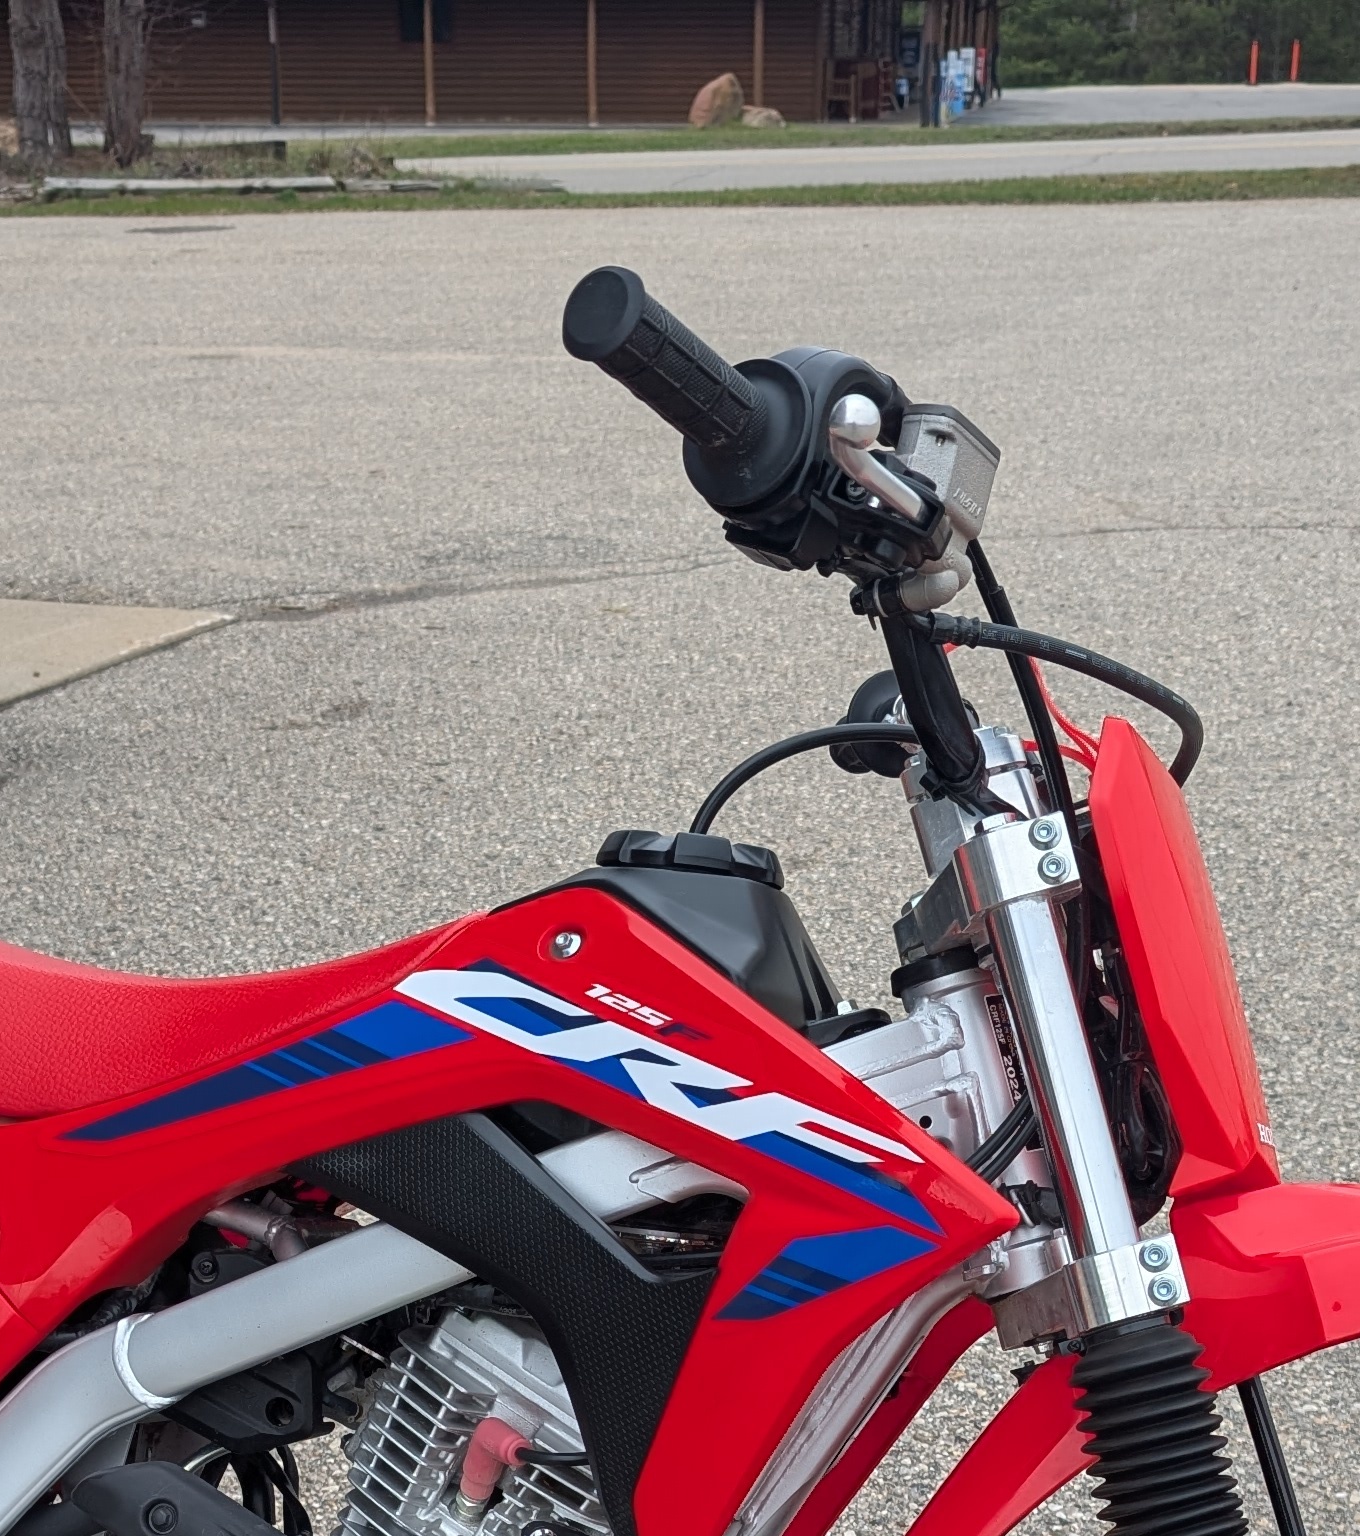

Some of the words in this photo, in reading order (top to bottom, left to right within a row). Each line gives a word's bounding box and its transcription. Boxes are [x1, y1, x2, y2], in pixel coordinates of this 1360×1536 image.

[583, 982, 713, 1042] 125F
[393, 968, 925, 1164] CRF
[1003, 1055, 1023, 1101] 2024
